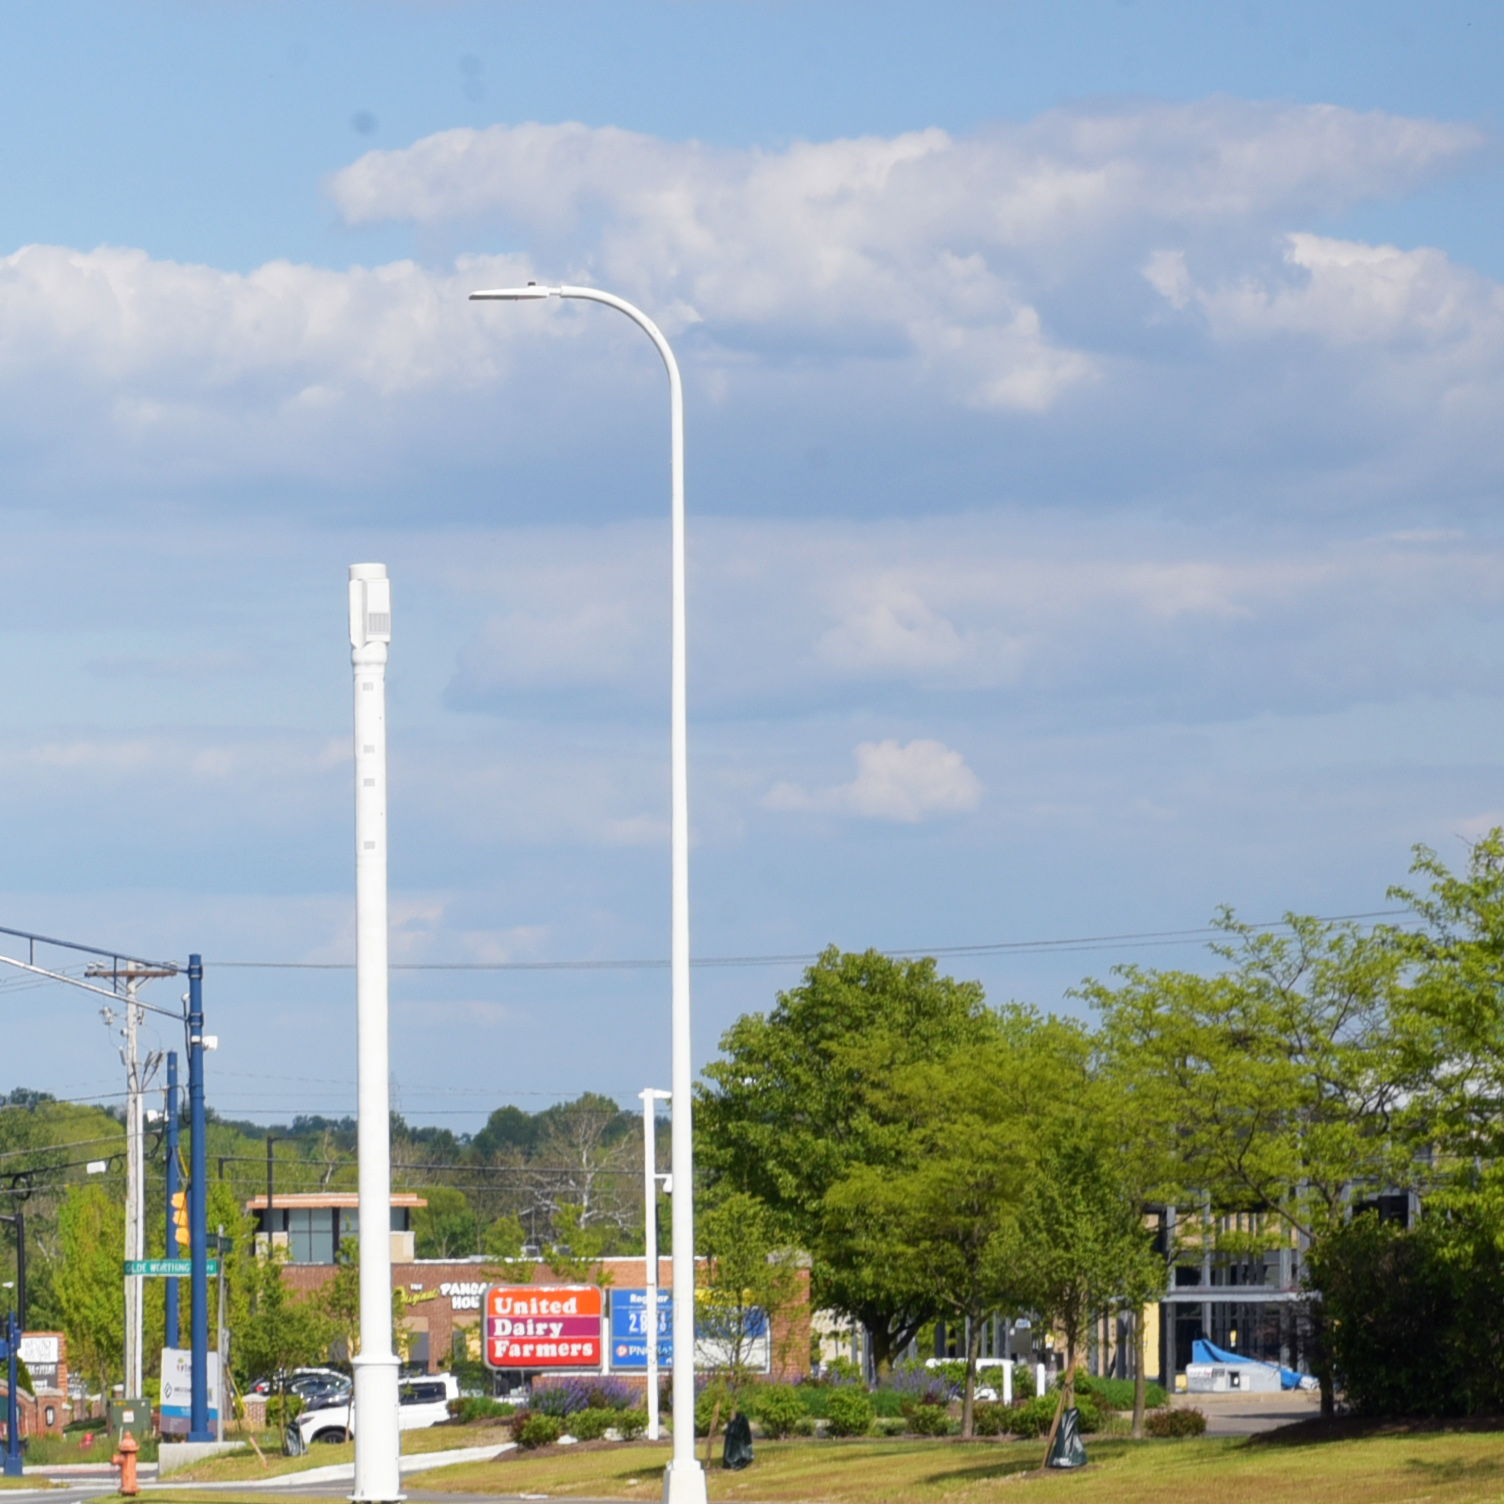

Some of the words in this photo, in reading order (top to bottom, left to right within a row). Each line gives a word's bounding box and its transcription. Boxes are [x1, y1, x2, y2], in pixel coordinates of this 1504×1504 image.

[494, 1297, 578, 1315] United
[494, 1318, 563, 1339] Dairy
[494, 1340, 593, 1358] Farmers
